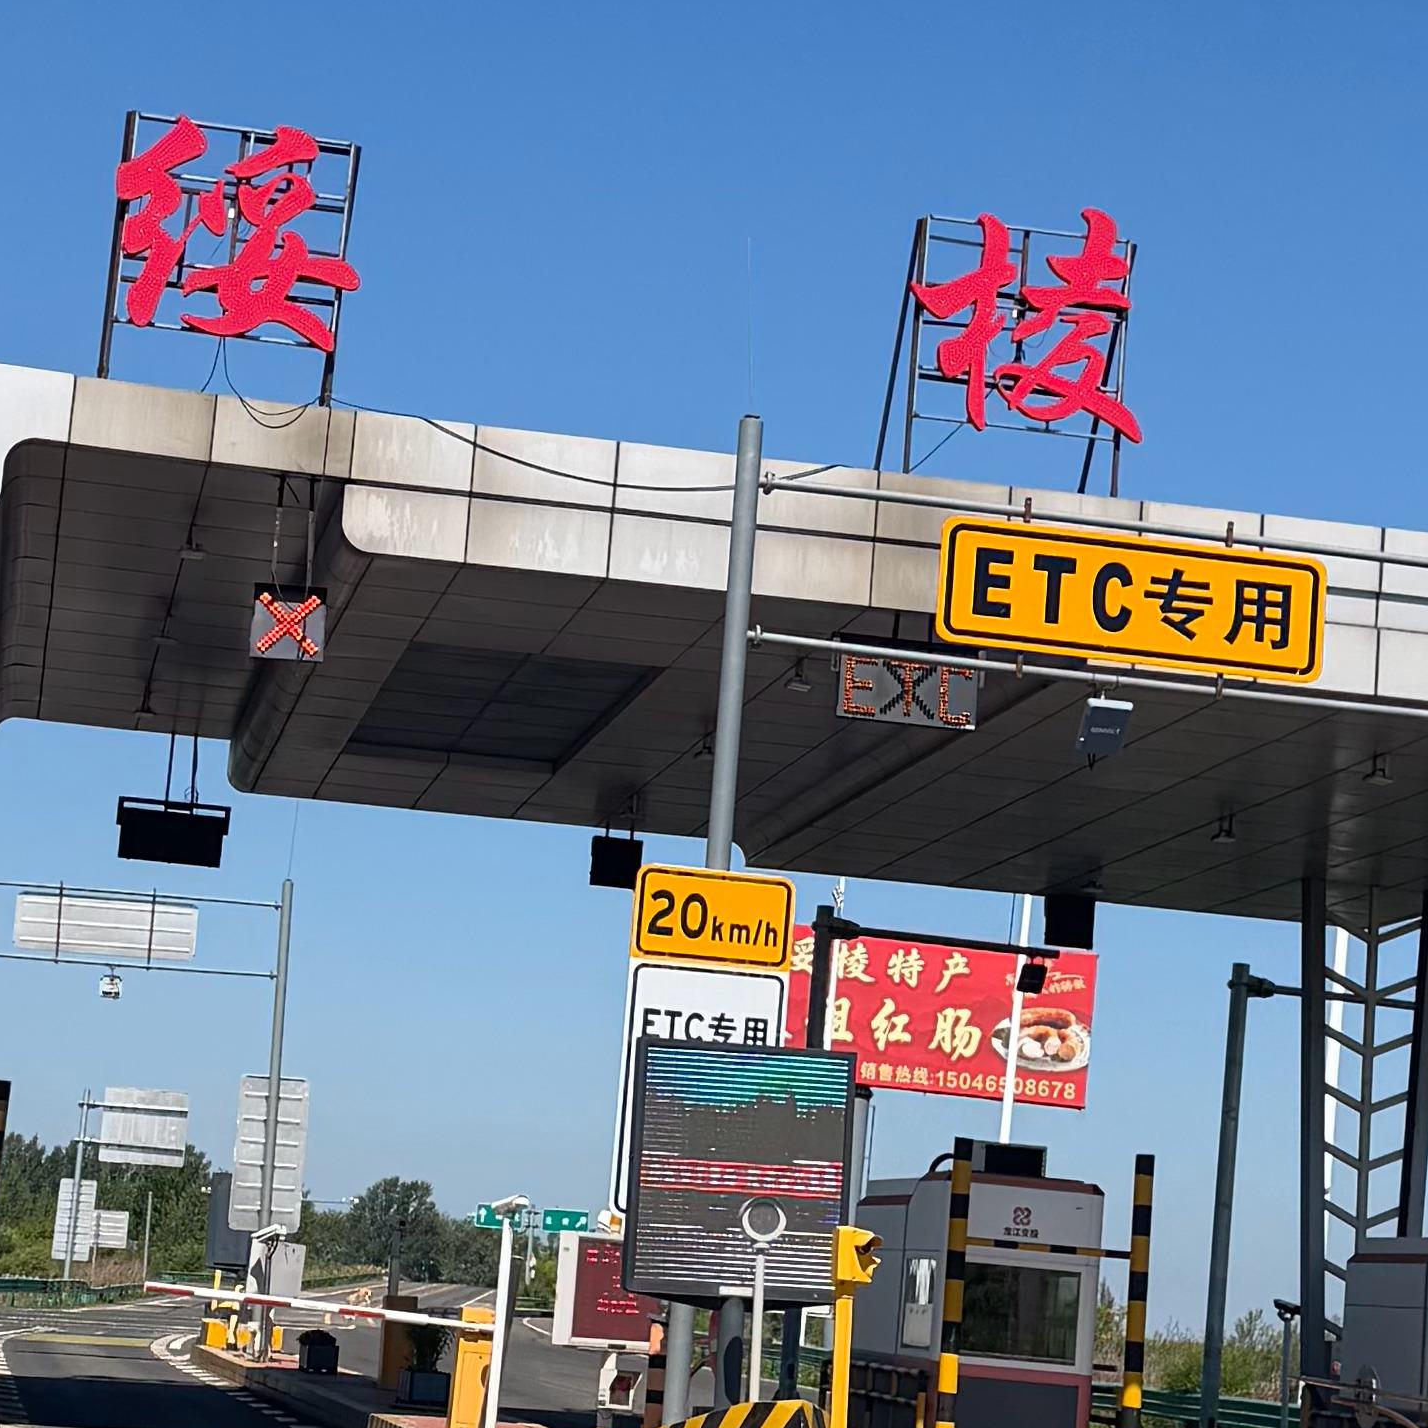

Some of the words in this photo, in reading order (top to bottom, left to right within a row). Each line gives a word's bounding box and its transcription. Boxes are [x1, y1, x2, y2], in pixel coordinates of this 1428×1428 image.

[972, 547, 1293, 650] ETC专用
[647, 889, 778, 947] 20km/h
[641, 1006, 768, 1046] ETC专用
